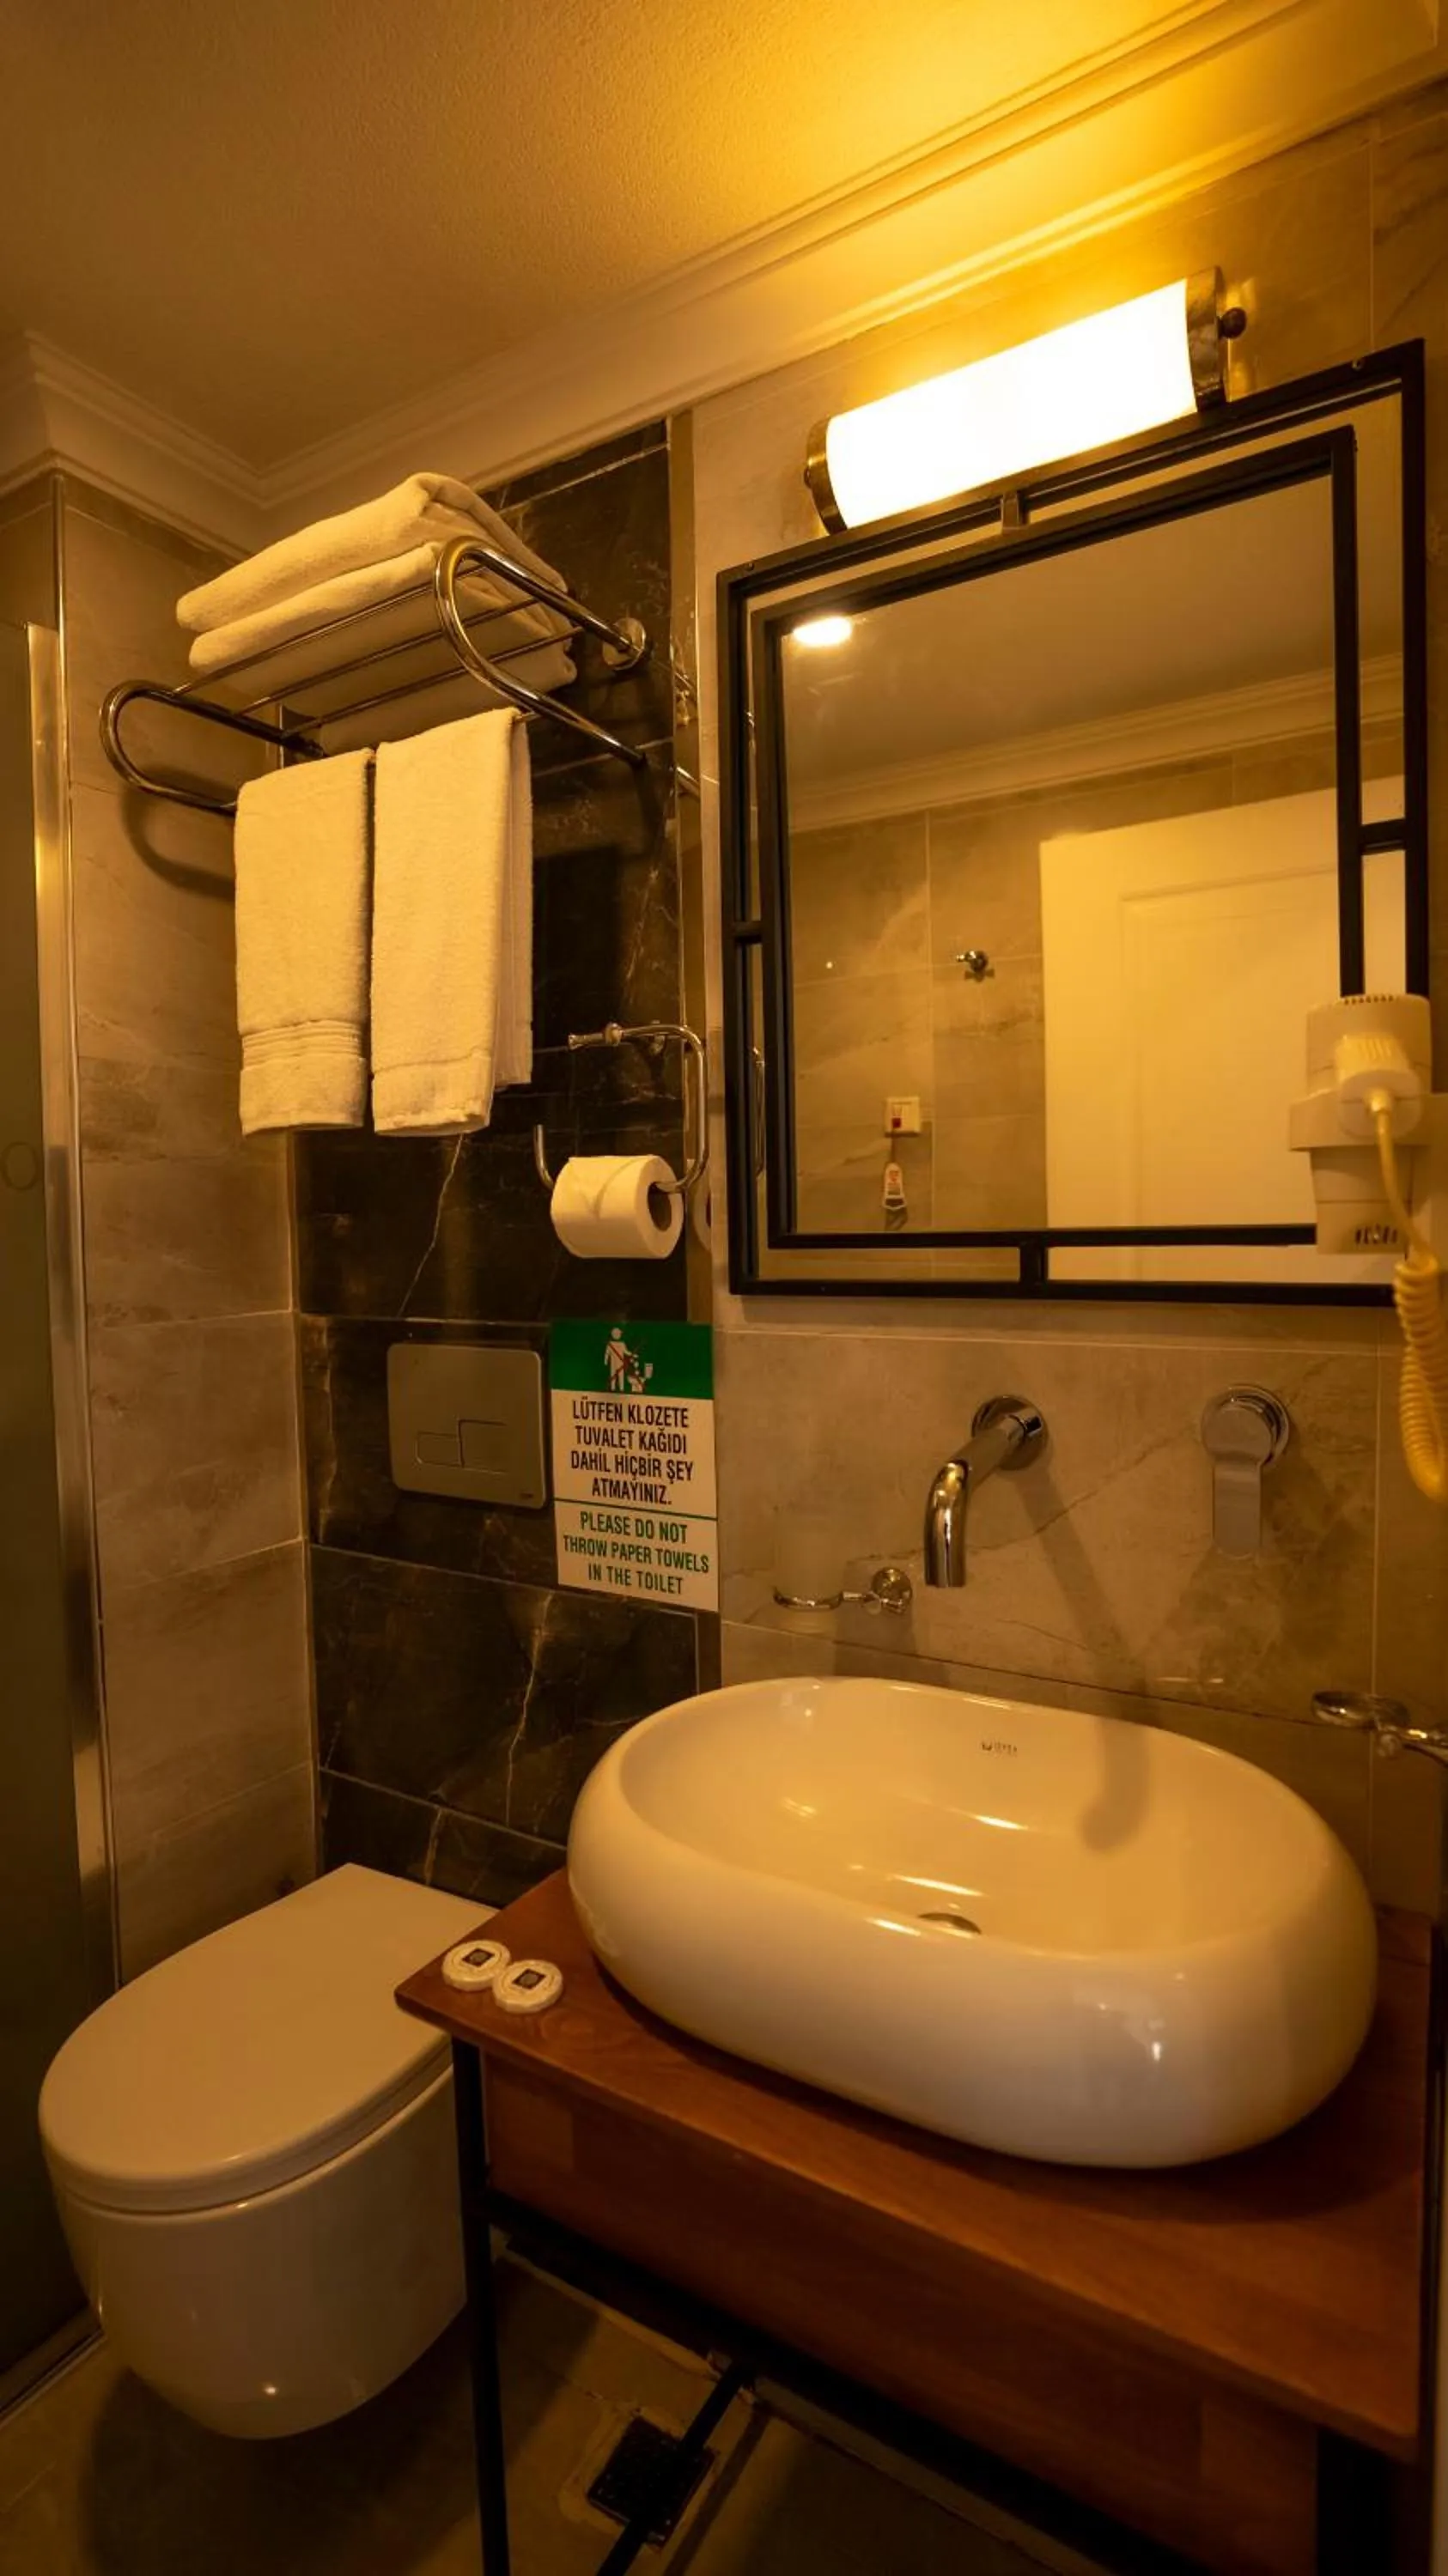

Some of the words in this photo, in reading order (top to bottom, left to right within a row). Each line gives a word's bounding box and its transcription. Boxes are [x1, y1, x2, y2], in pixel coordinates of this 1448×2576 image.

[574, 1397, 623, 1423] LÜTFEN
[628, 1405, 688, 1428] KLOZETE
[575, 1425, 634, 1449] TUVALET
[639, 1427, 687, 1455] KAĞIDI
[571, 1449, 610, 1473] DAHİL
[615, 1450, 661, 1482] HİÇBİR
[666, 1460, 693, 1484] ŞEY
[592, 1478, 672, 1504] ATMAYINIZ.
[581, 1511, 630, 1536] PLEASE
[636, 1519, 653, 1539] DO
[660, 1522, 687, 1544] NOT
[563, 1535, 607, 1556] THROW
[611, 1542, 652, 1564] PAPER
[656, 1549, 709, 1573] TOWELS
[588, 1564, 601, 1581] IN
[607, 1566, 631, 1586] THE
[637, 1571, 683, 1595] TOILET
